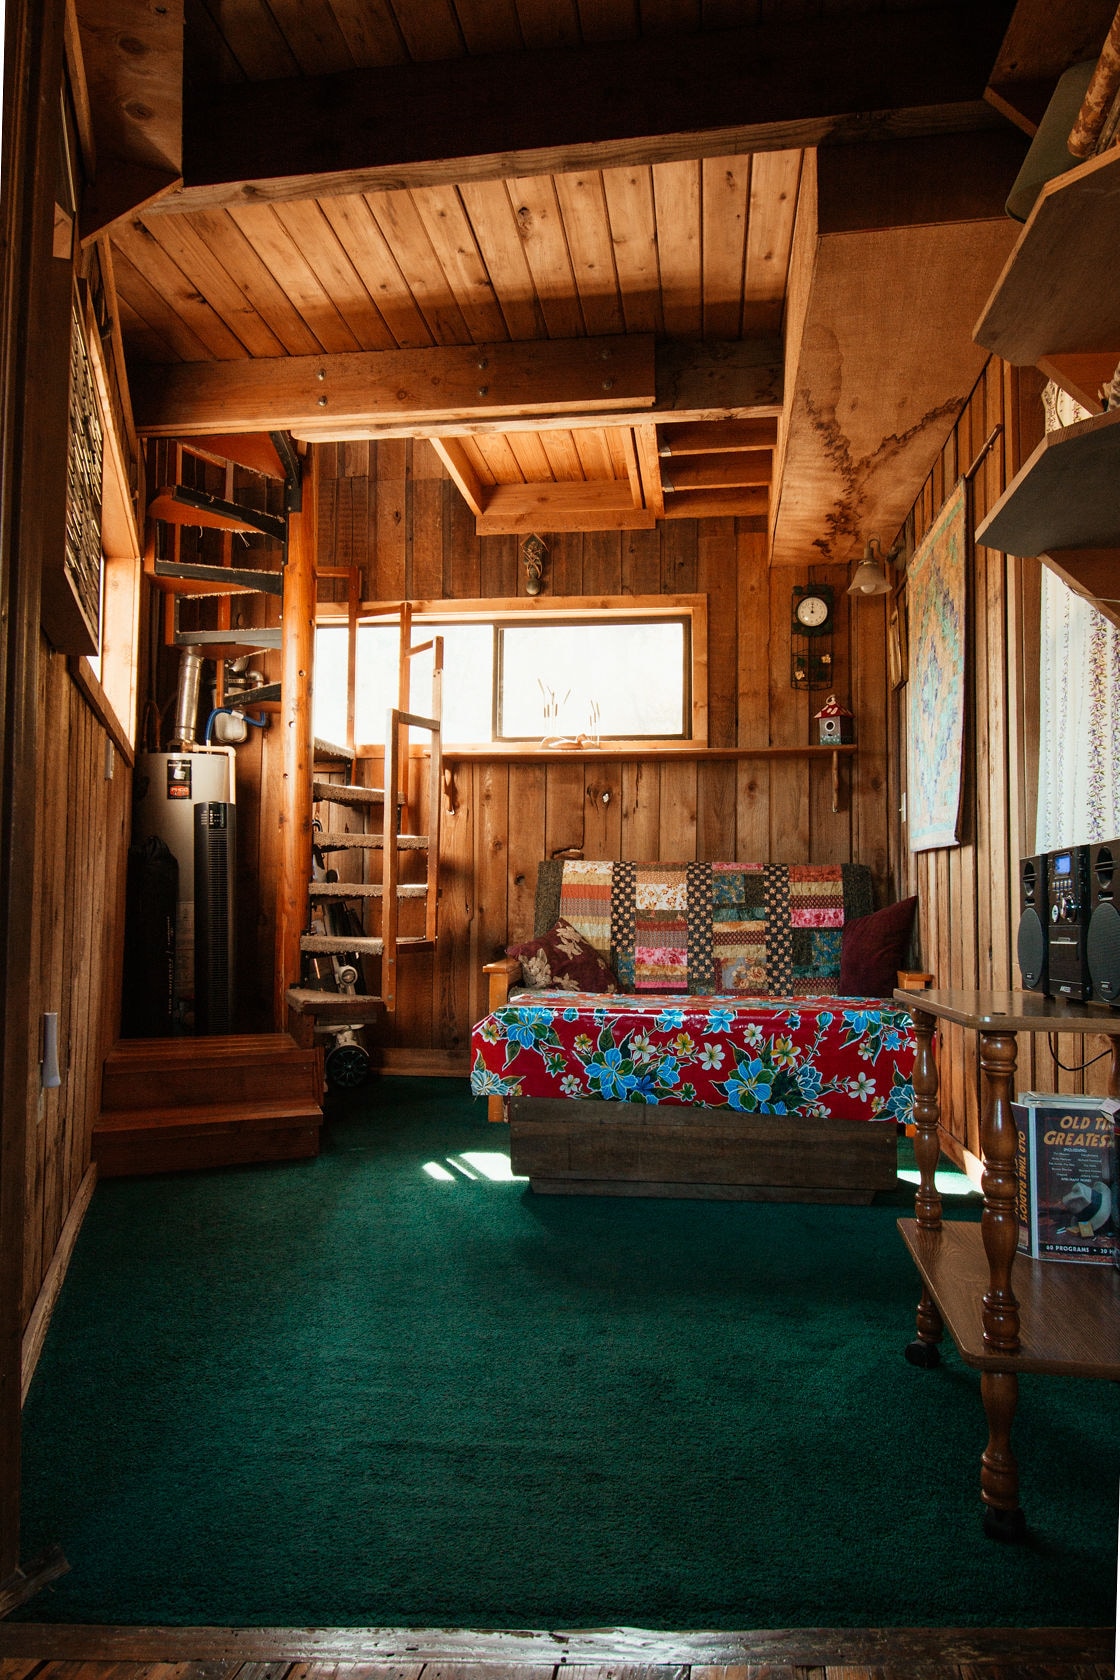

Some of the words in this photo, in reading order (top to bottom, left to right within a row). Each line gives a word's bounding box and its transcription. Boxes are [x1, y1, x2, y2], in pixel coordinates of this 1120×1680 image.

[1060, 1115, 1091, 1130] OLD
[1018, 1130, 1026, 1154] OLD
[1043, 1130, 1115, 1147] GREATES
[1019, 1154, 1027, 1180] TIME
[1019, 1179, 1028, 1225] RADIO'S
[1055, 1245, 1090, 1253] PROGRAMS
